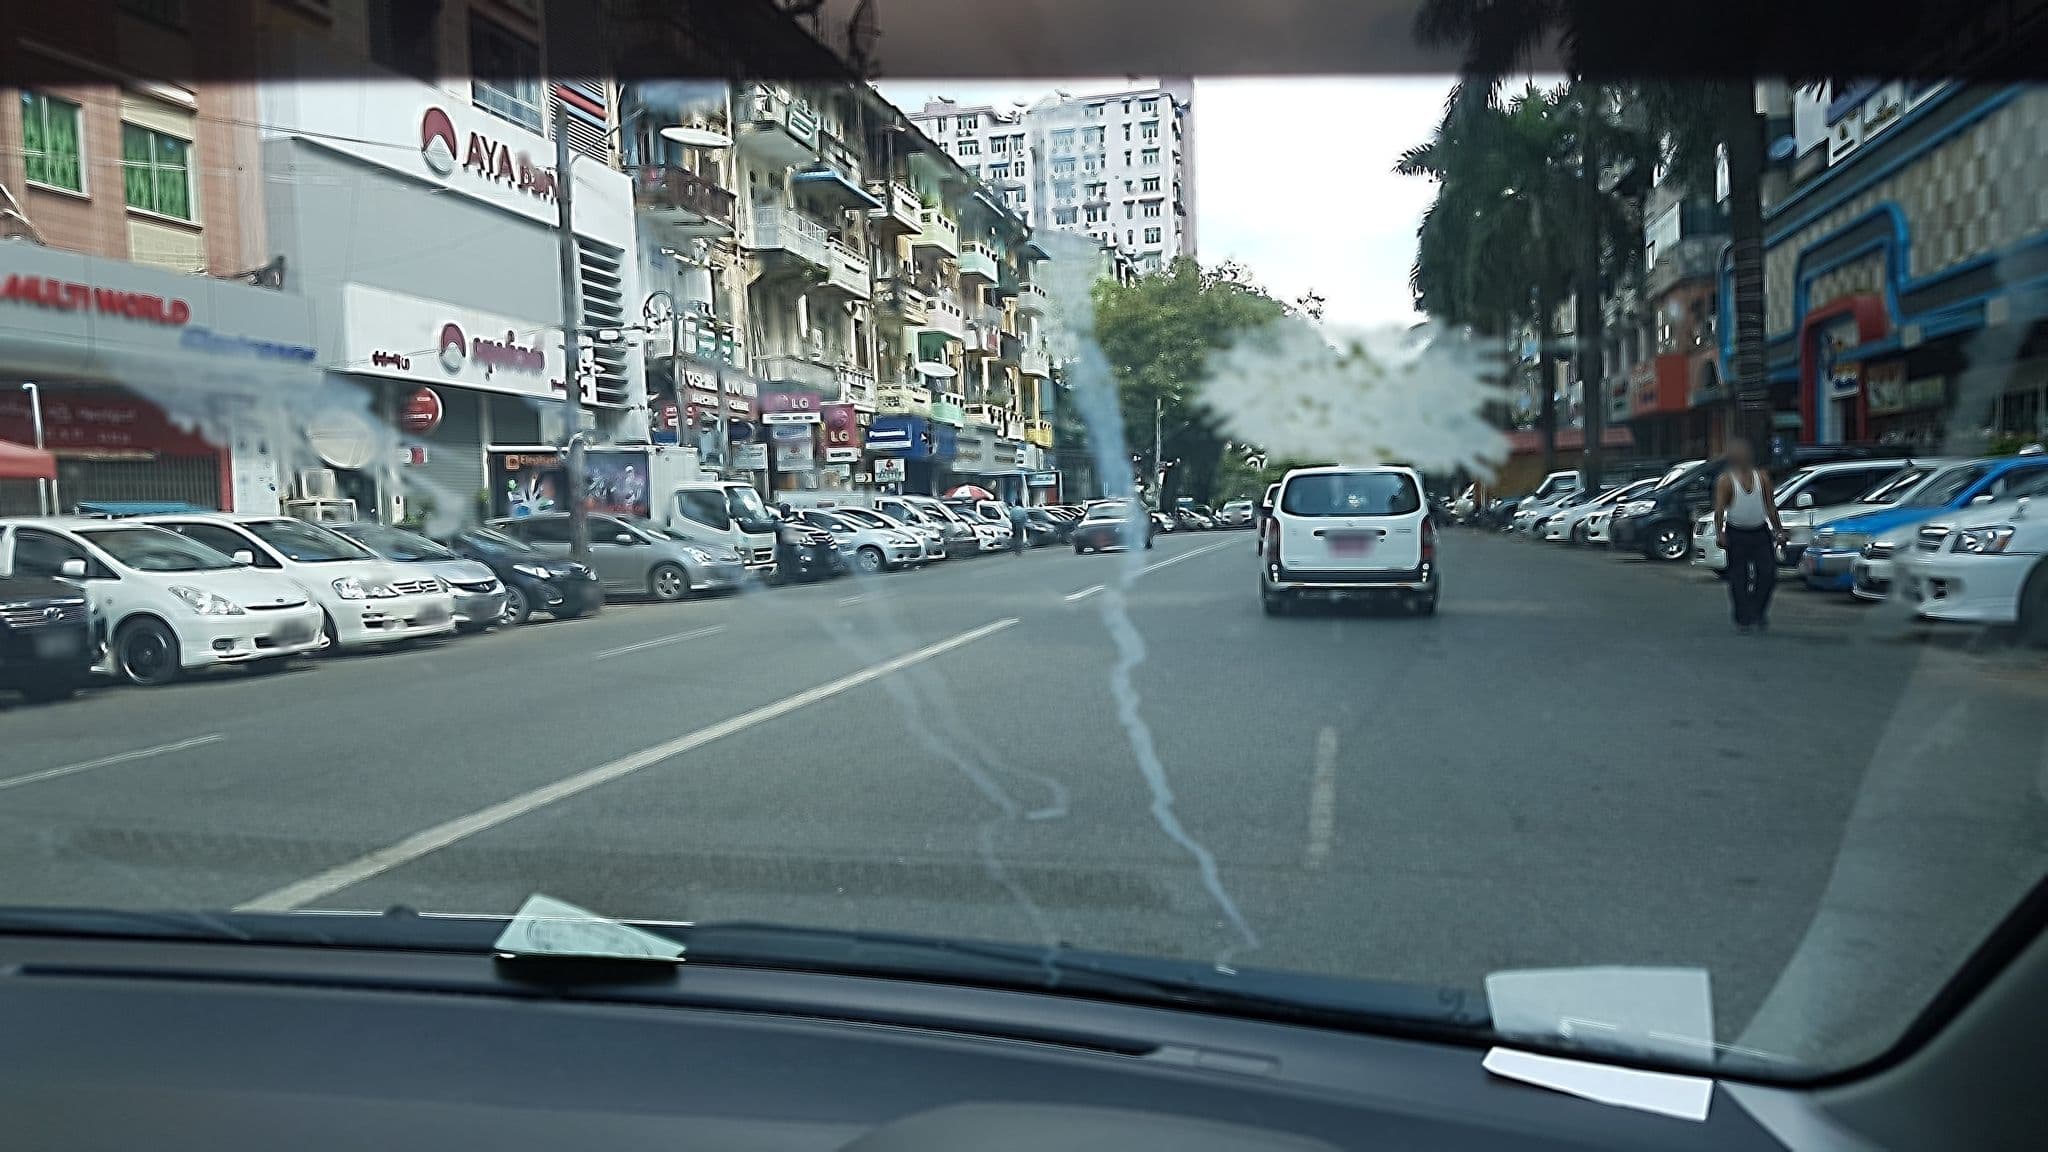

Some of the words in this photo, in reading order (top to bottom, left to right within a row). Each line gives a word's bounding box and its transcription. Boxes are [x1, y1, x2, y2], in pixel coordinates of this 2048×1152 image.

[463, 131, 515, 184] AYA
[517, 154, 560, 202] Ban
[0, 273, 91, 310] MULTI
[94, 287, 191, 325] WORLD
[791, 398, 809, 409] LG
[830, 429, 849, 442] LG
